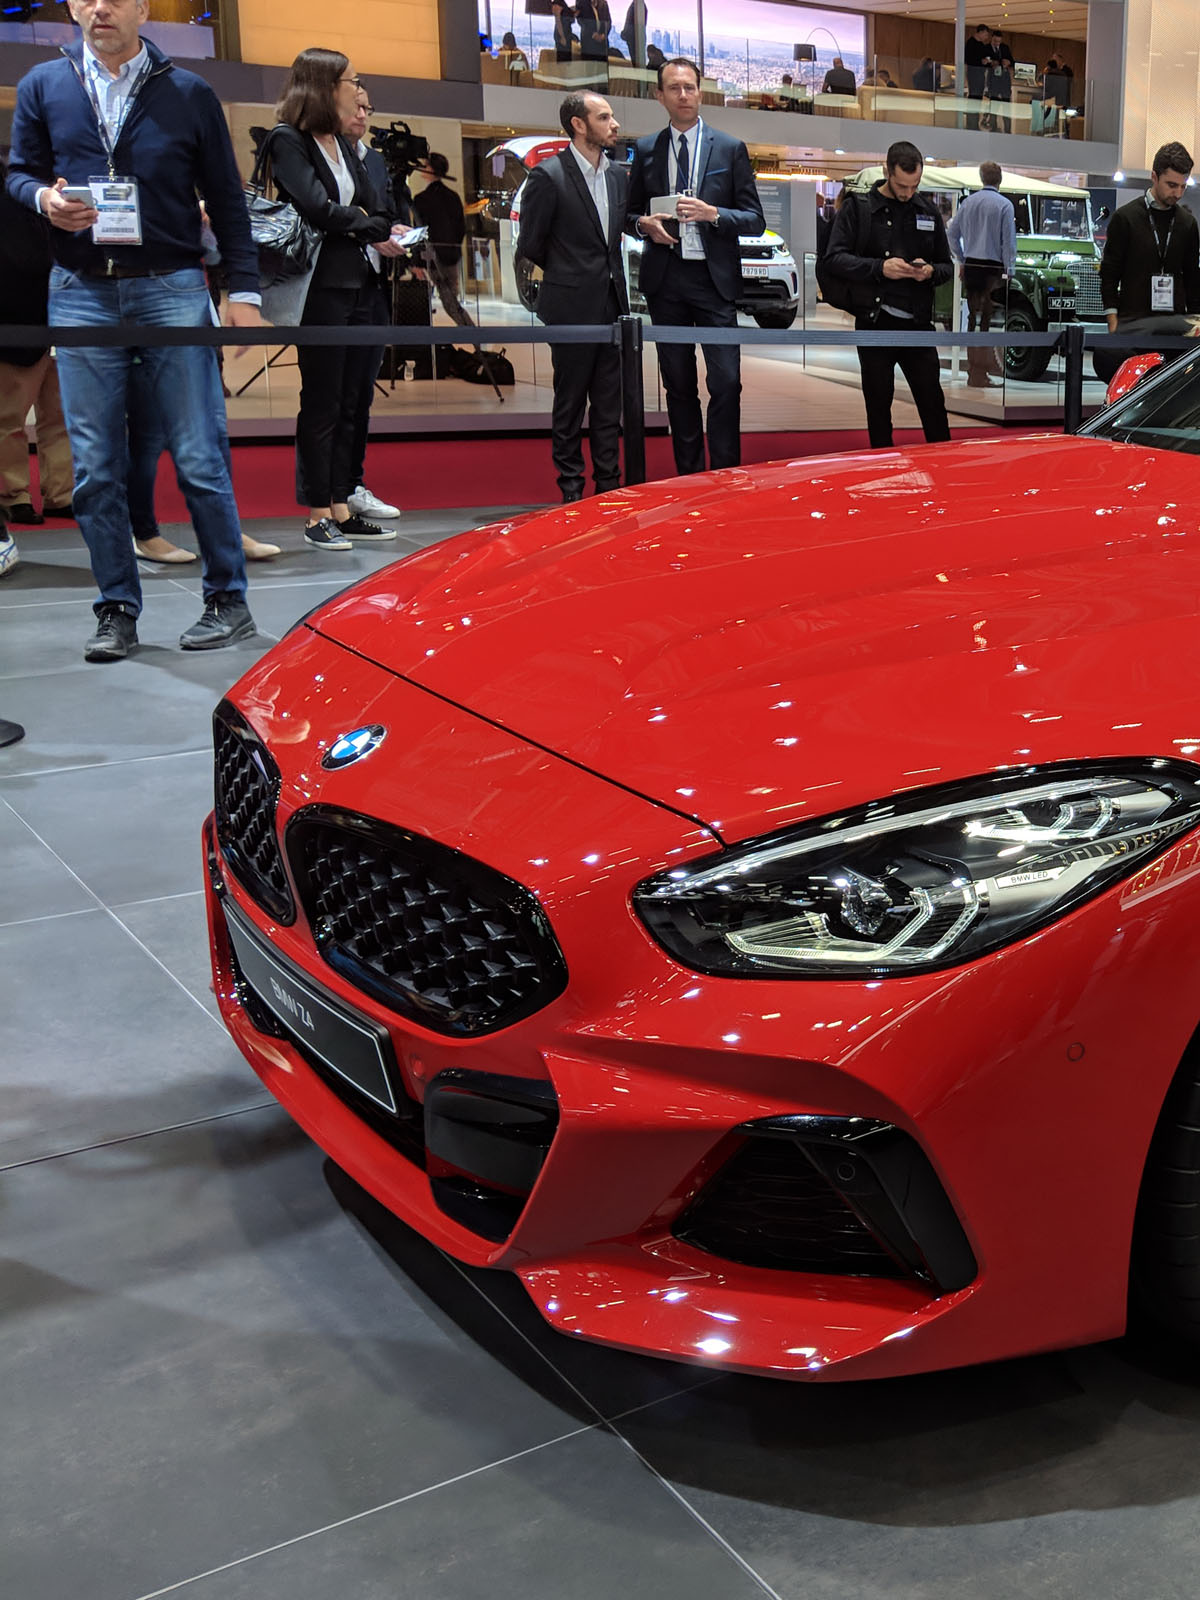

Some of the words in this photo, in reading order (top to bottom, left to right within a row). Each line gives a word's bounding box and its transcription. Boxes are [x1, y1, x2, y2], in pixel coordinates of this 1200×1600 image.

[1011, 873, 1031, 883] BMW
[1033, 871, 1048, 880] LED
[270, 977, 298, 1017] BMW
[297, 1002, 315, 1031] Z4
